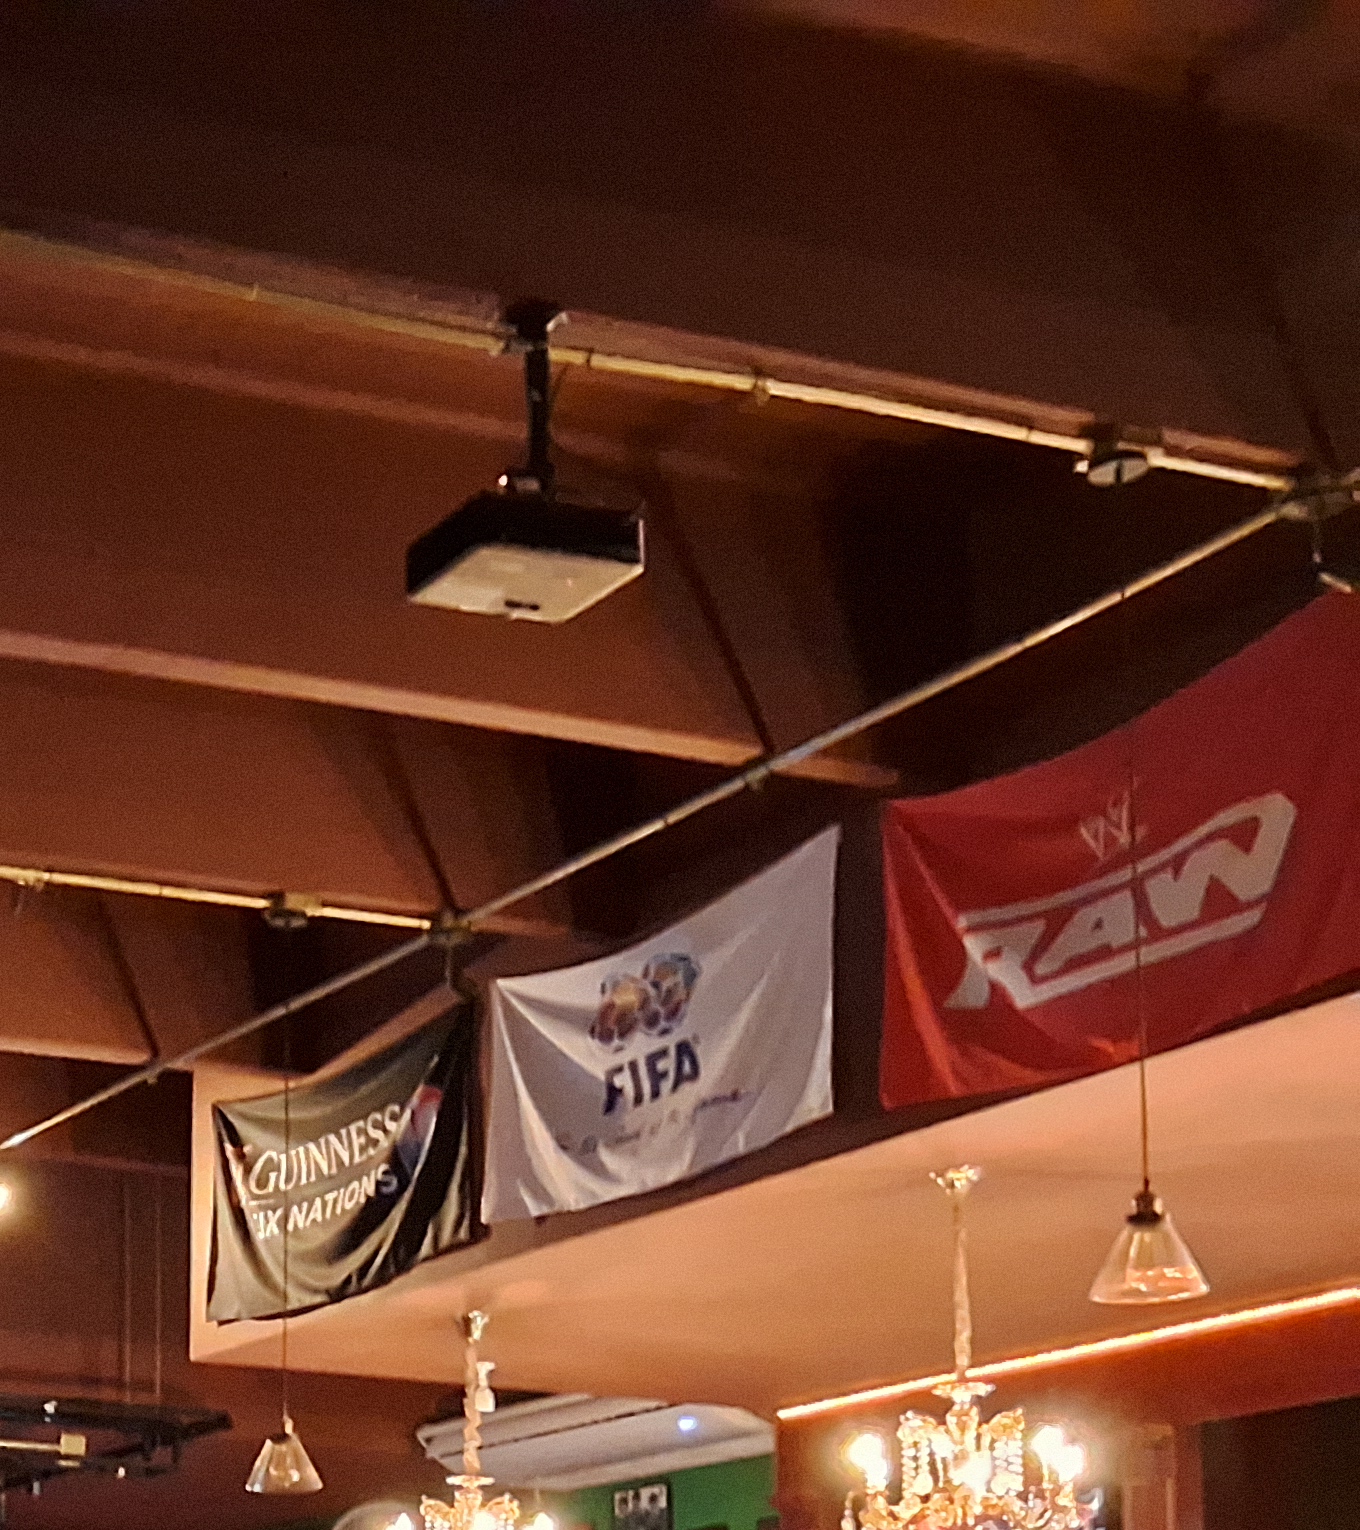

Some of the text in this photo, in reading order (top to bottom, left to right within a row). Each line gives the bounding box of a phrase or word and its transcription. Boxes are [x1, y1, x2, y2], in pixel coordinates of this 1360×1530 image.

[943, 793, 1297, 1011] RAW
[603, 1039, 700, 1117] FIFA
[248, 1103, 401, 1195] GUINNESS
[251, 1163, 399, 1241] IX NATIONS
